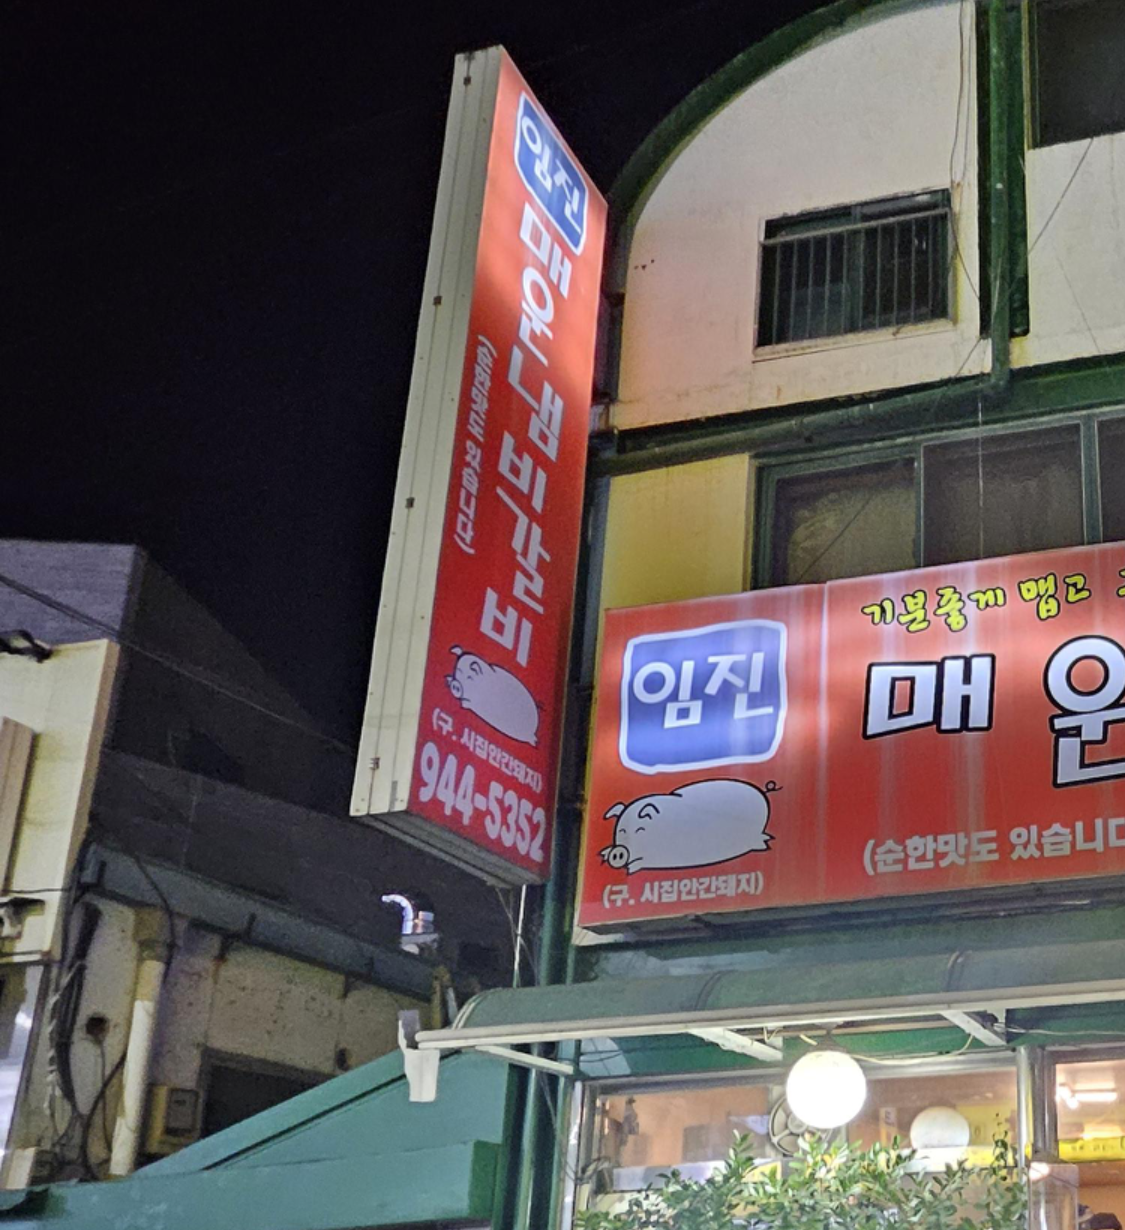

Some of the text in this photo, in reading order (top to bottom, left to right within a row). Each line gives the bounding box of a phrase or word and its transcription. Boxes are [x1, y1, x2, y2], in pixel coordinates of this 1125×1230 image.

[521, 115, 582, 235] 임진
[453, 439, 482, 555] 있습니다)
[1018, 573, 1091, 620] 맵고
[633, 651, 774, 729] 임진
[419, 741, 546, 863] 944-5352
[640, 870, 764, 903] 시집안간돼지)
[863, 829, 1000, 876] (순한맛도
